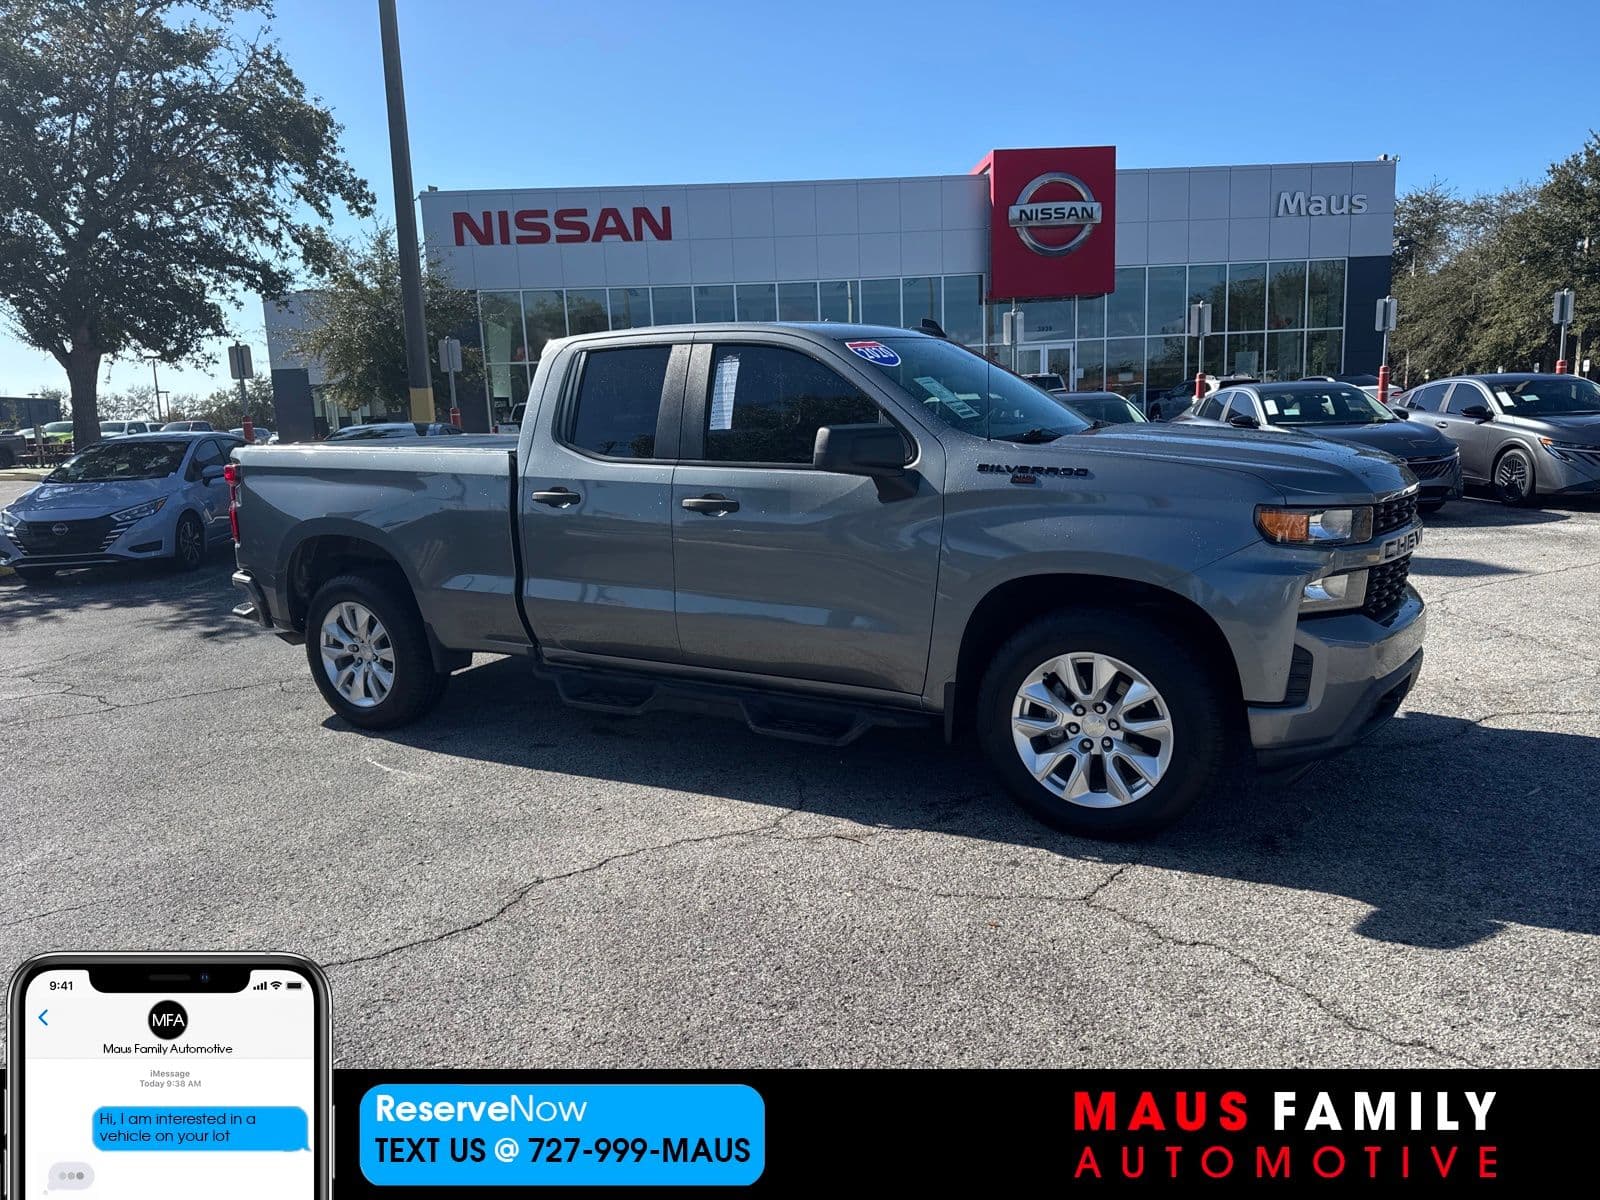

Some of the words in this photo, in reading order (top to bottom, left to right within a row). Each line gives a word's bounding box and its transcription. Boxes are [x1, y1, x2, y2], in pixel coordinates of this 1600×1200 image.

[1019, 206, 1094, 222] NISSAN
[1278, 191, 1368, 217] Maus
[452, 206, 673, 247] NISSAN
[977, 464, 1089, 477] SILVERADO
